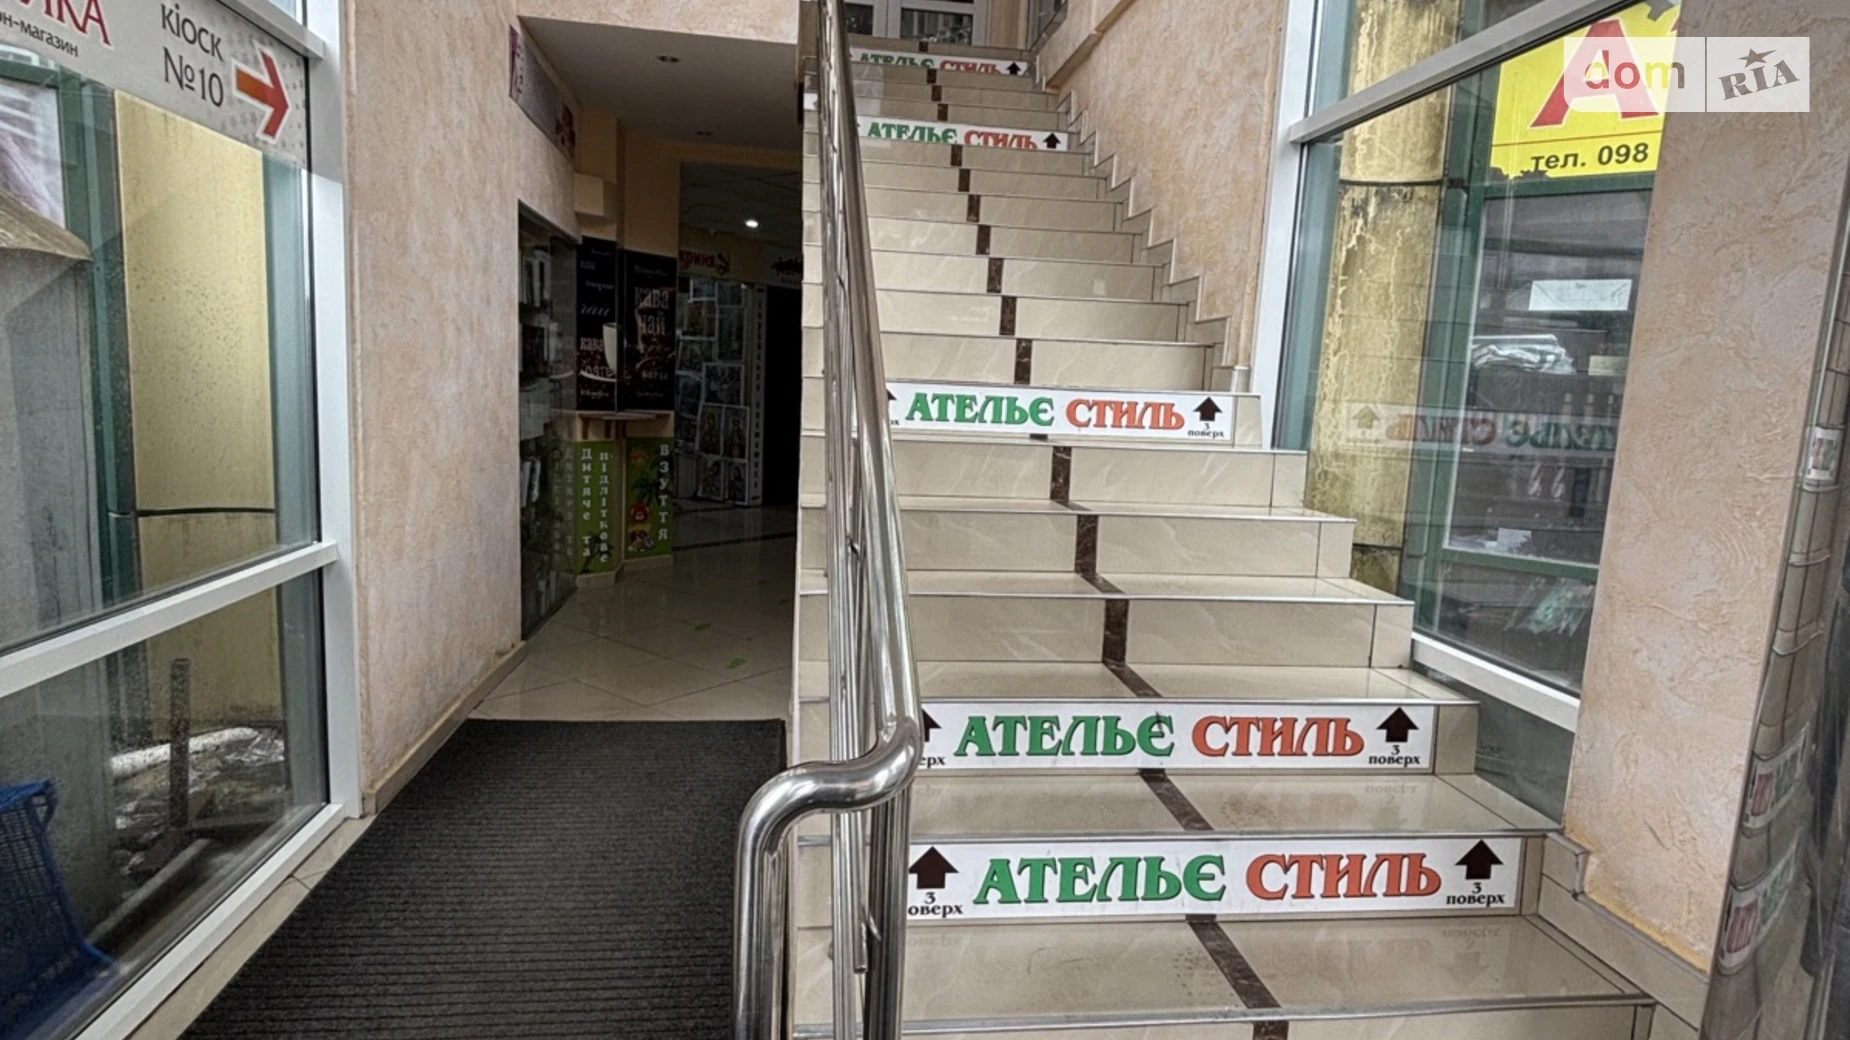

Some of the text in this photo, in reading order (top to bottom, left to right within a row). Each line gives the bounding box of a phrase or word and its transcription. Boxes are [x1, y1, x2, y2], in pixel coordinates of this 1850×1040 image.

[161, 3, 224, 62] кіоск
[867, 122, 1038, 151] АТЕЛЬЄ СТИЛЬ
[1531, 142, 1649, 171] тел. 098
[905, 392, 1185, 430] АТЕЛЬЄ СТИЛЬ
[953, 712, 1365, 757] АТЕЛЬЄ СТИЛЬ
[1391, 744, 1401, 756] 3
[1368, 755, 1421, 768] поверх
[973, 852, 1442, 905] АТЕЛЬЄ СТИЛЬ
[1472, 882, 1482, 894] 3
[925, 891, 936, 905] 3
[1446, 894, 1505, 907] поверх
[908, 904, 963, 918] оверх
